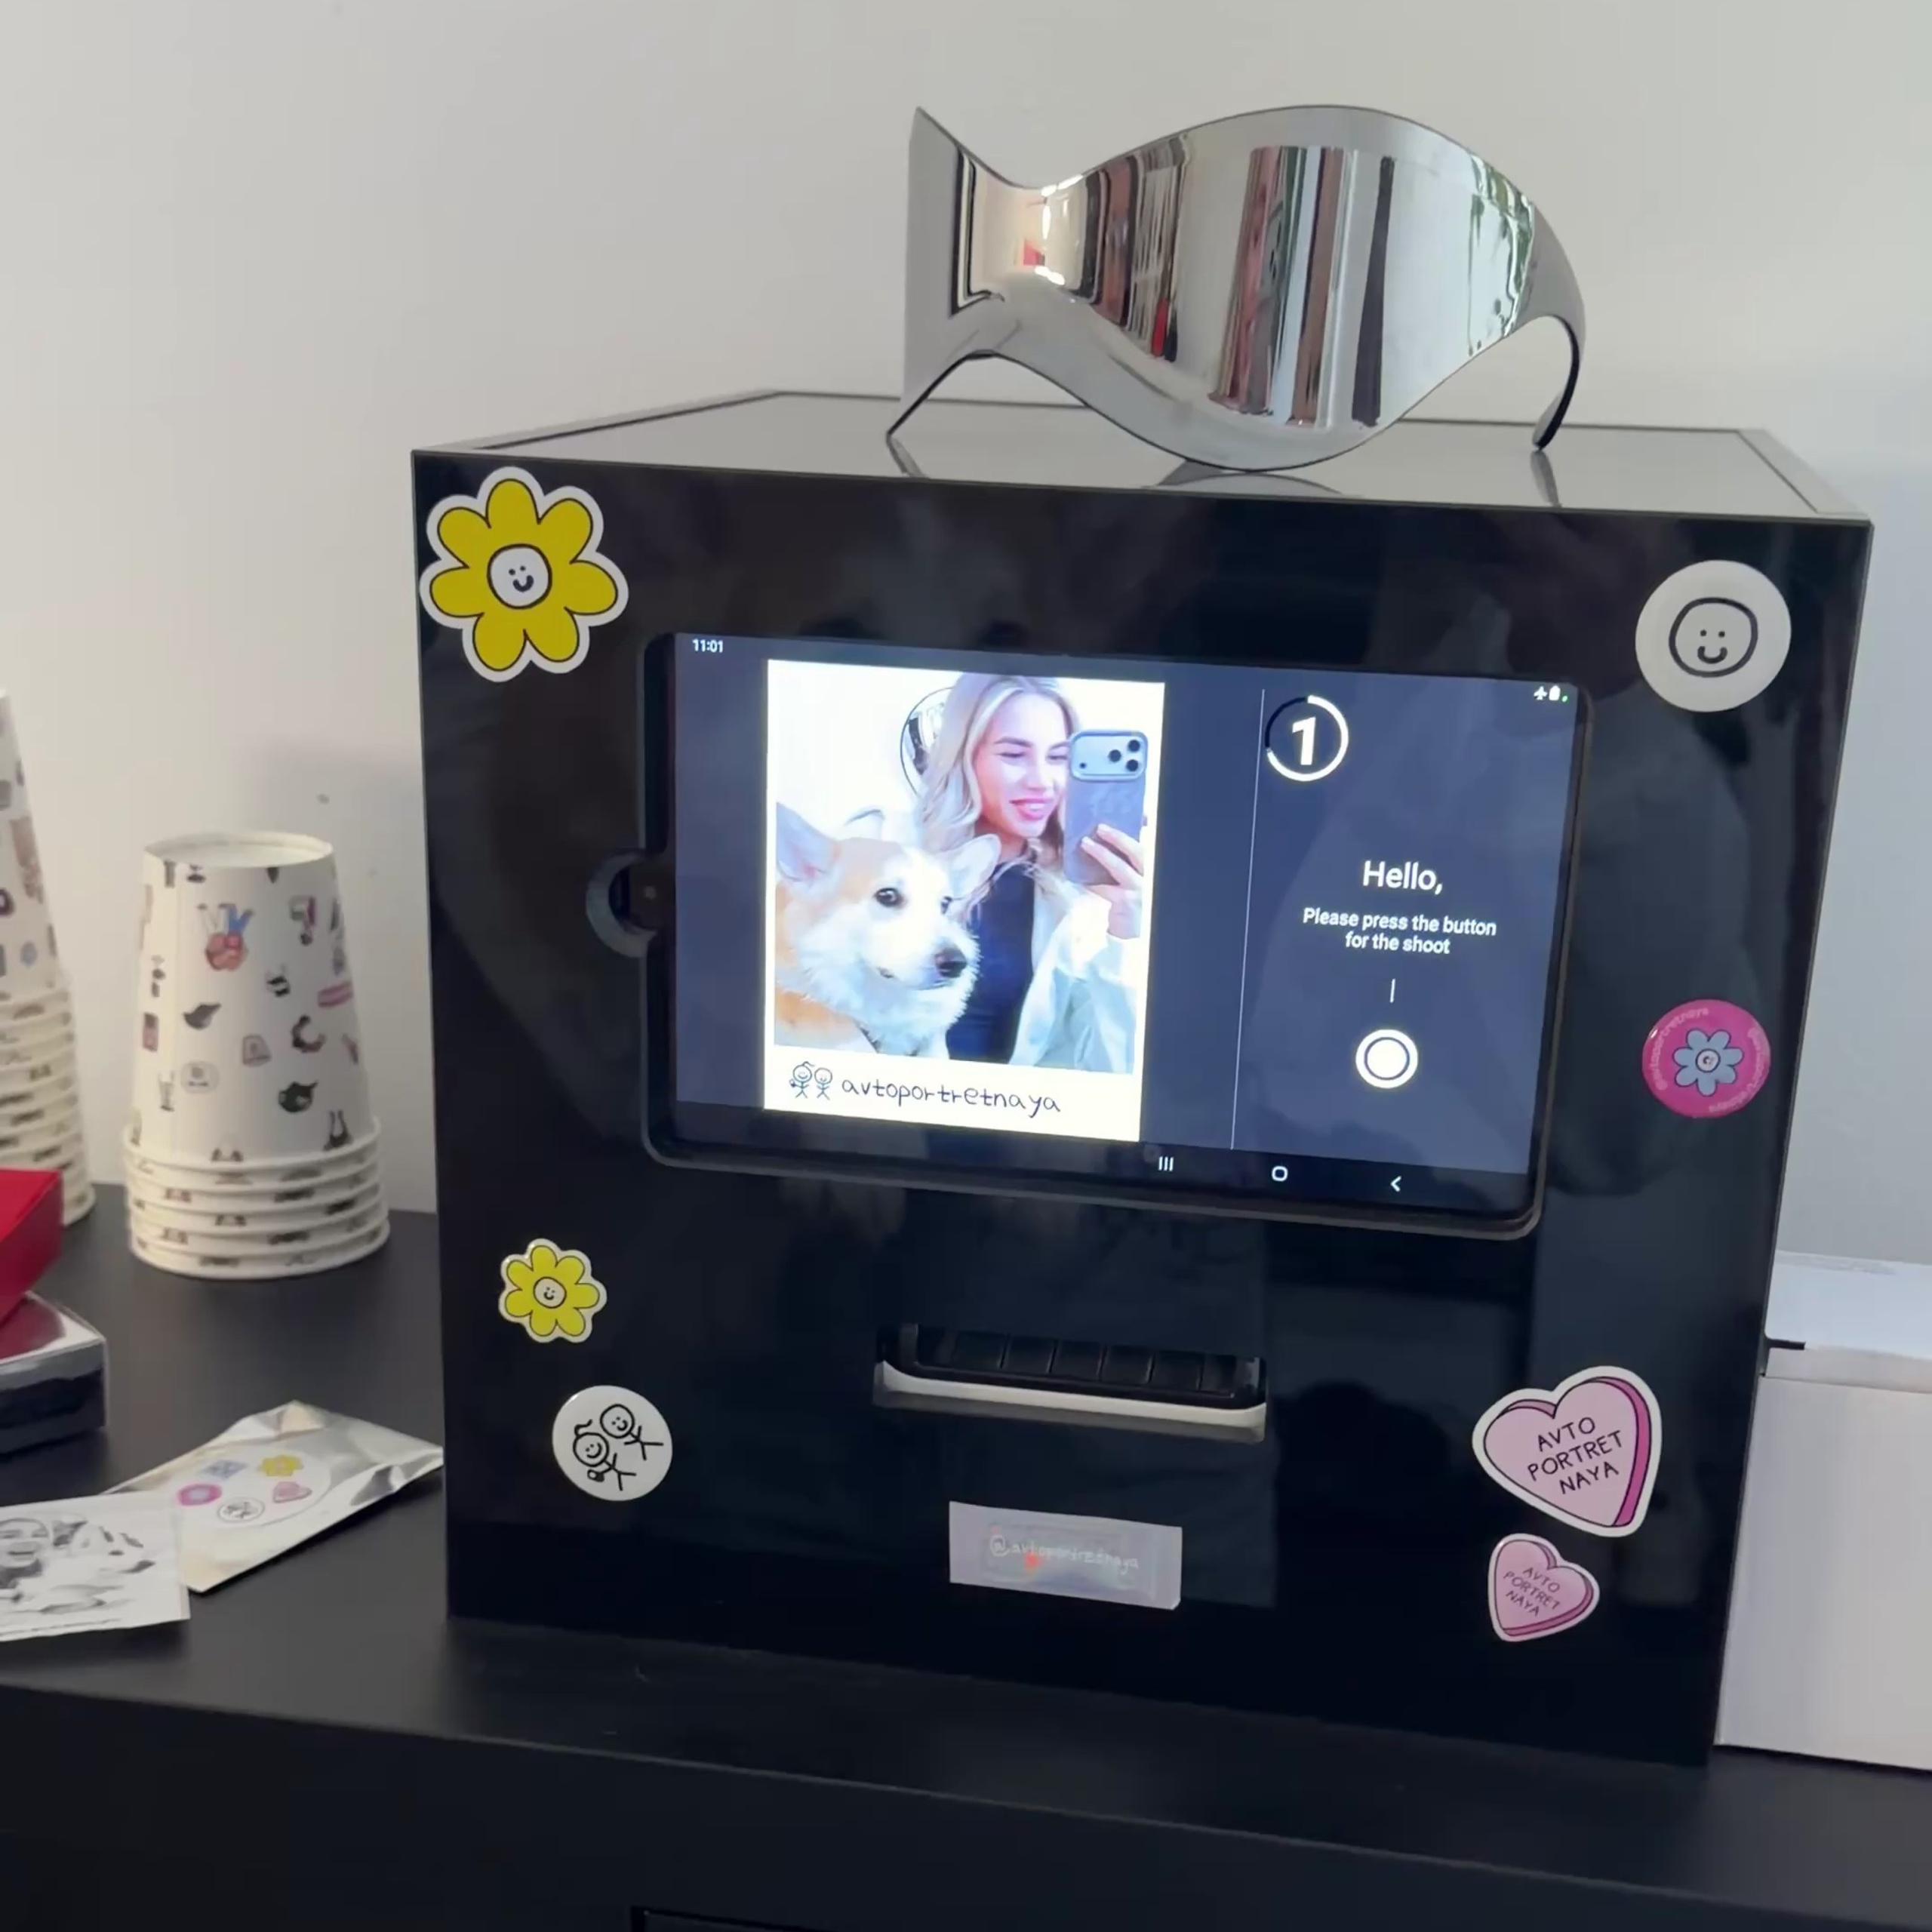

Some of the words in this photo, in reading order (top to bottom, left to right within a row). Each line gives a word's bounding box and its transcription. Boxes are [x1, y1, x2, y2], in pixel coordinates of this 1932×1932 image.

[692, 638, 724, 653] 11:01
[1291, 715, 1316, 765] 1
[1362, 860, 1443, 895] Hello,
[1303, 906, 1359, 927] Please
[1361, 912, 1408, 931] press
[1411, 914, 1439, 933] the
[1442, 915, 1497, 936] button
[1345, 931, 1369, 949] for
[1372, 932, 1399, 951] the
[1402, 934, 1451, 954] shoot
[841, 1078, 1061, 1118] avtoportretnaya
[1537, 1417, 1596, 1452] AVTO
[1527, 1429, 1623, 1482] PORTRET
[1559, 1461, 1620, 1495] NAYA
[1503, 1571, 1561, 1611] PORTRET
[1522, 1567, 1561, 1593] AVTO
[1505, 1590, 1540, 1617] NAYA
